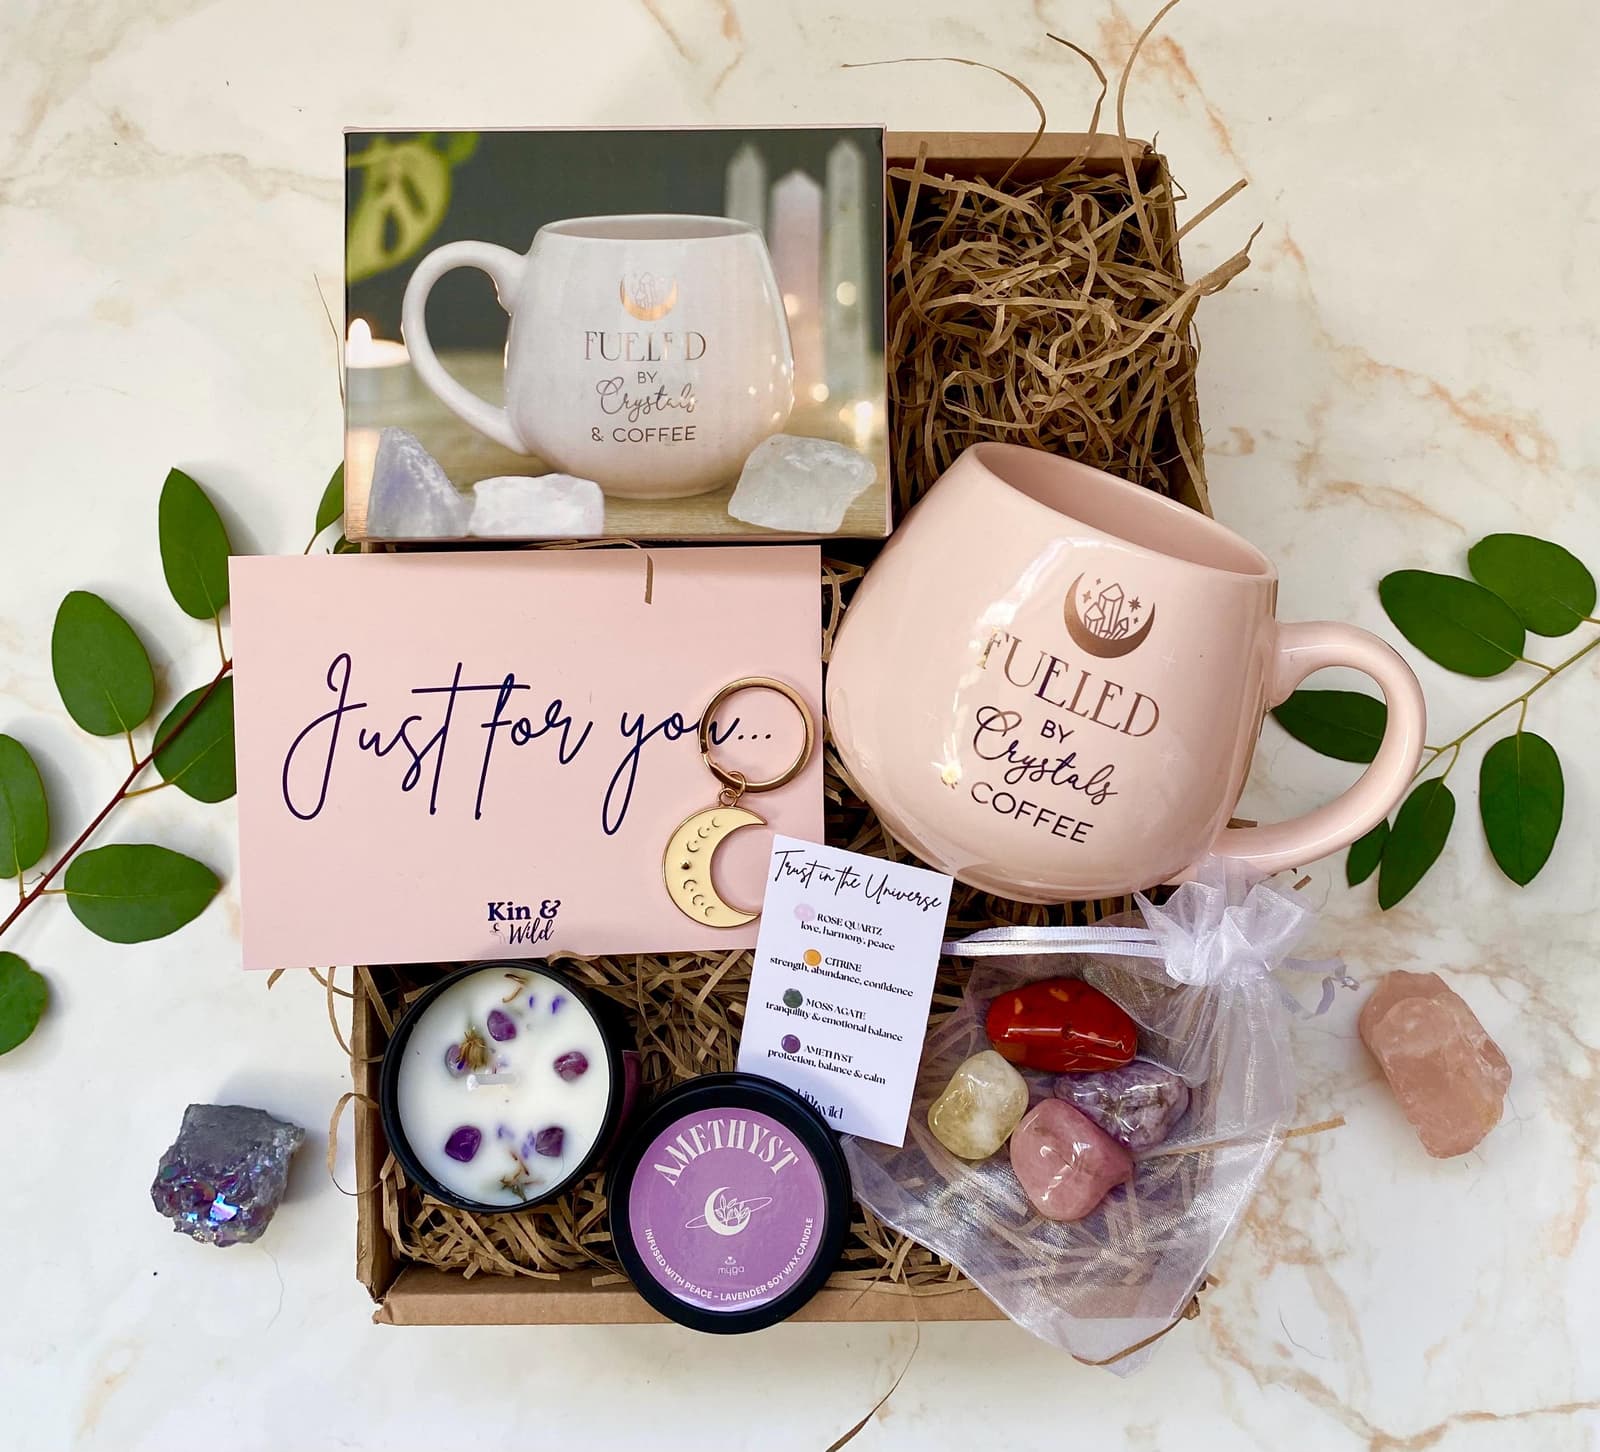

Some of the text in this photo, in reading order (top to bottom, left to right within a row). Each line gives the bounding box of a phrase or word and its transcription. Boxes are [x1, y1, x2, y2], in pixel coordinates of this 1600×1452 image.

[637, 371, 658, 384] BY
[591, 425, 697, 443] & COFFEE
[977, 626, 1160, 738] FUELED
[282, 653, 530, 821] Just
[475, 673, 594, 821] for
[1040, 719, 1075, 744] BY
[973, 705, 1119, 806] Crystals
[970, 781, 1094, 844] COFFEE
[774, 849, 942, 912] Trust in the Universe
[487, 899, 562, 921] Kin &
[816, 912, 884, 937] ROSE QUARTZ
[509, 917, 555, 945] Wild
[800, 920, 896, 952] love, harmony, peace
[769, 955, 914, 998] strength, abundance, confidence
[824, 955, 863, 973] CITRINE
[765, 1001, 904, 1042] tranquility & emotional balance
[805, 997, 867, 1021] MOSS AGATE
[767, 1048, 887, 1085] protection, balance & calm
[804, 1044, 854, 1064] AMETHYST
[653, 1118, 800, 1187] AMETHYST
[644, 1228, 667, 1267] INFUSED
[664, 1264, 686, 1286] WITH
[684, 1281, 713, 1299] PEACE
[720, 1284, 768, 1301] LAVENDER
[766, 1271, 785, 1289] SOY
[782, 1254, 801, 1275] WAX
[796, 1216, 814, 1256] CANDLE
